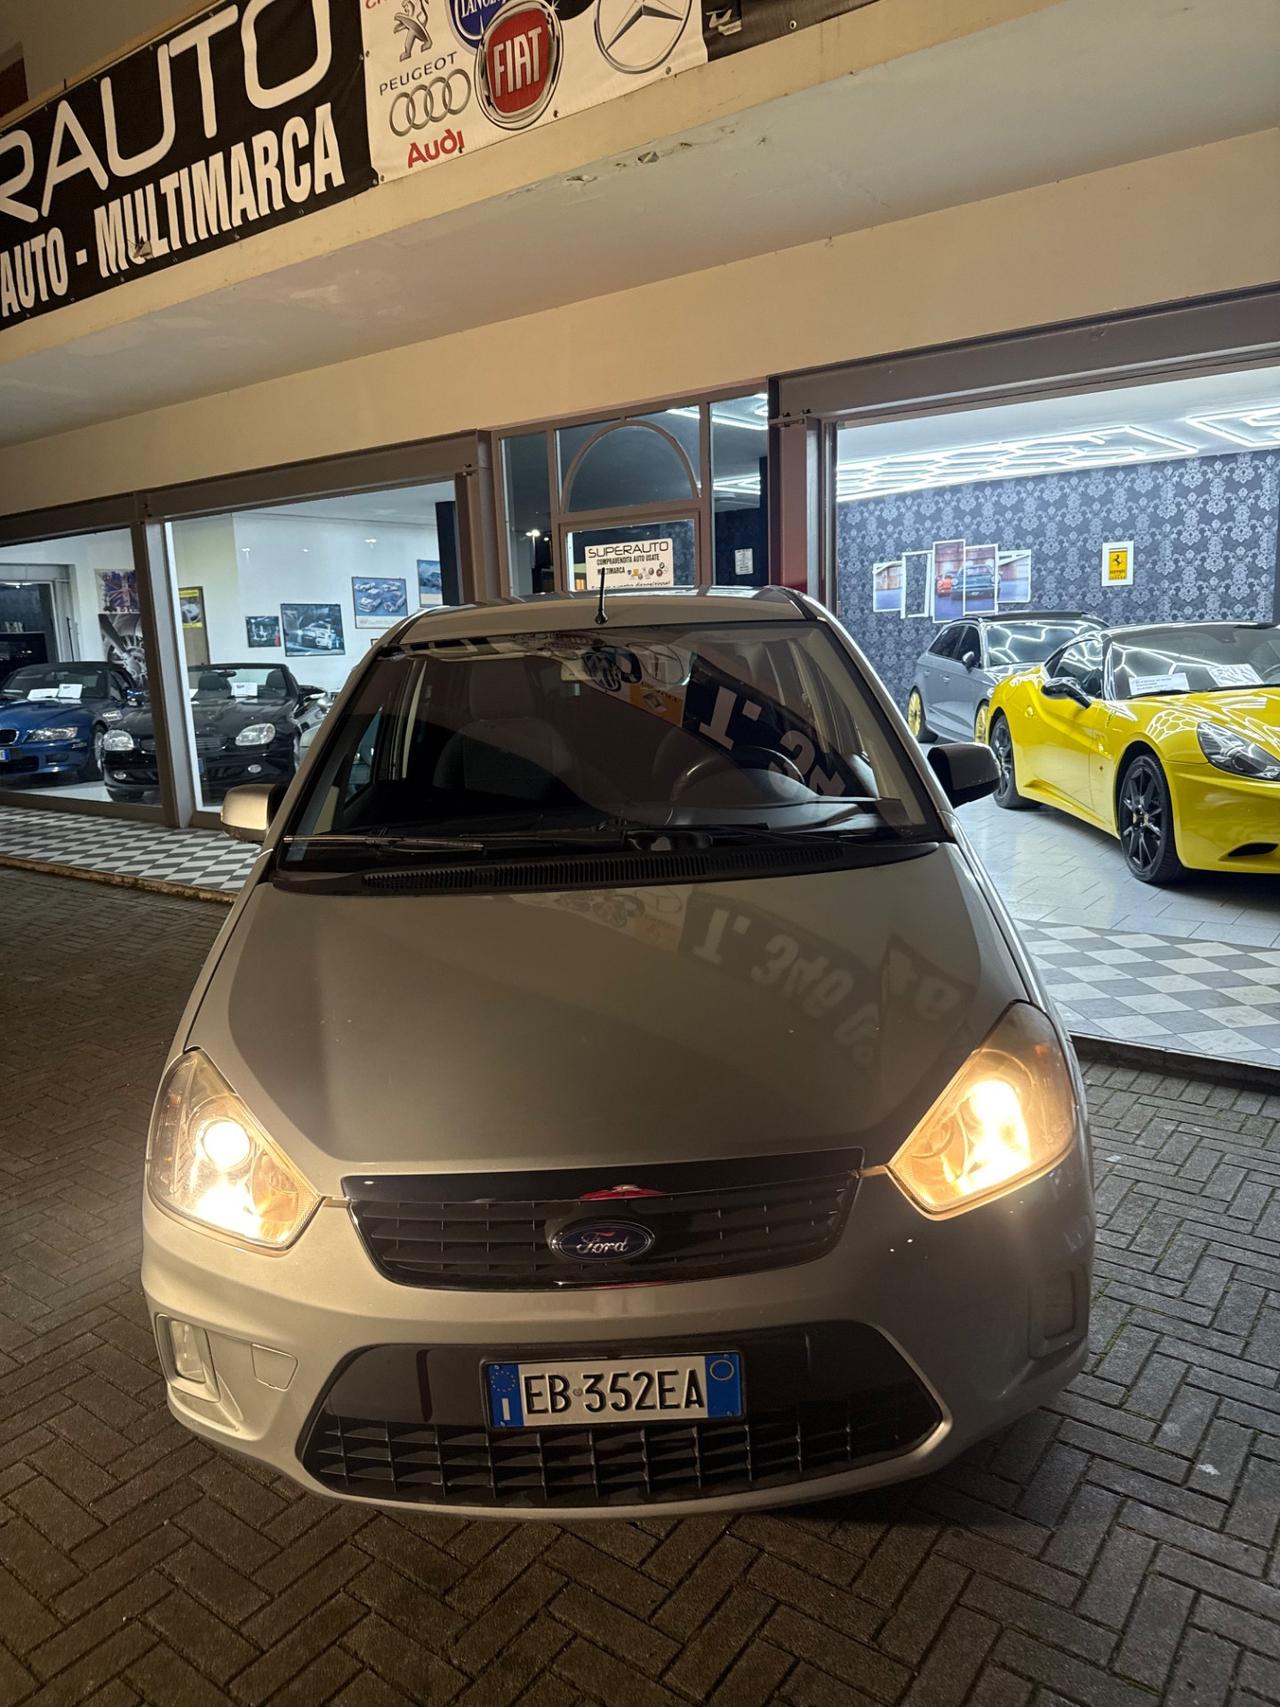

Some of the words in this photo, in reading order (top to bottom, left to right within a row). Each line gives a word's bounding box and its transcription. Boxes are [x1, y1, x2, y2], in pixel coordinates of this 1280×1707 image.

[378, 51, 458, 96] PEUGEOT
[493, 26, 543, 98] FIAT
[407, 128, 465, 169] Audi
[0, 227, 68, 318] AUTO
[94, 102, 346, 278] MULTIMARCA
[588, 541, 669, 558] SUPERAUTO
[576, 1231, 630, 1254] Ford
[524, 1373, 572, 1415] EB
[581, 1367, 705, 1413] 352EA
